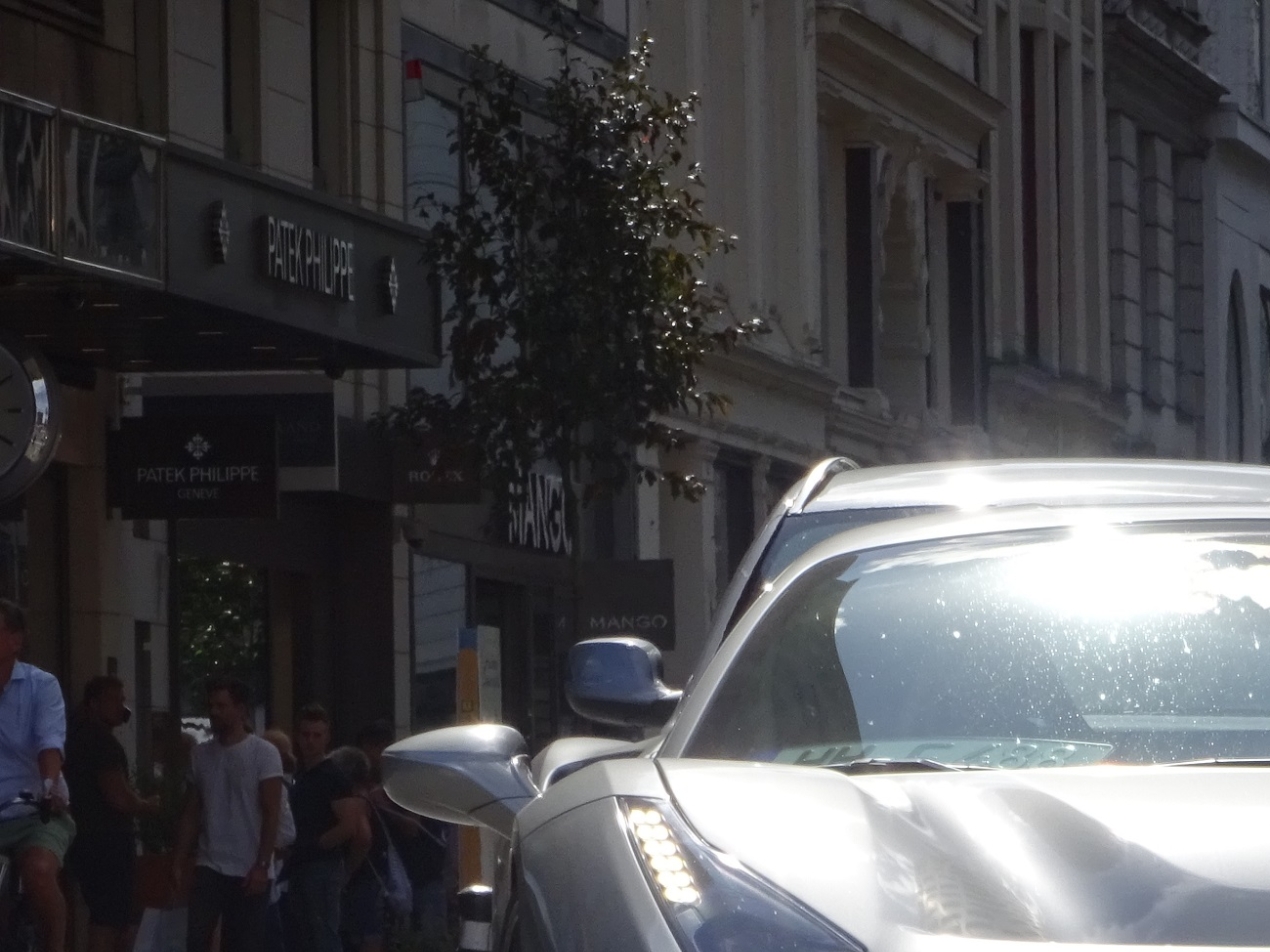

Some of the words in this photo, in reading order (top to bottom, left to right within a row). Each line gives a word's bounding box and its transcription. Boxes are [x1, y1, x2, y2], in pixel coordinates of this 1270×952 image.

[267, 215, 304, 285] PATEK
[305, 228, 355, 302] PHILIPPE
[137, 466, 186, 483] PATEK
[188, 465, 259, 483] PHILIPPE
[408, 470, 464, 483] ROX
[590, 613, 668, 629] MANGO
